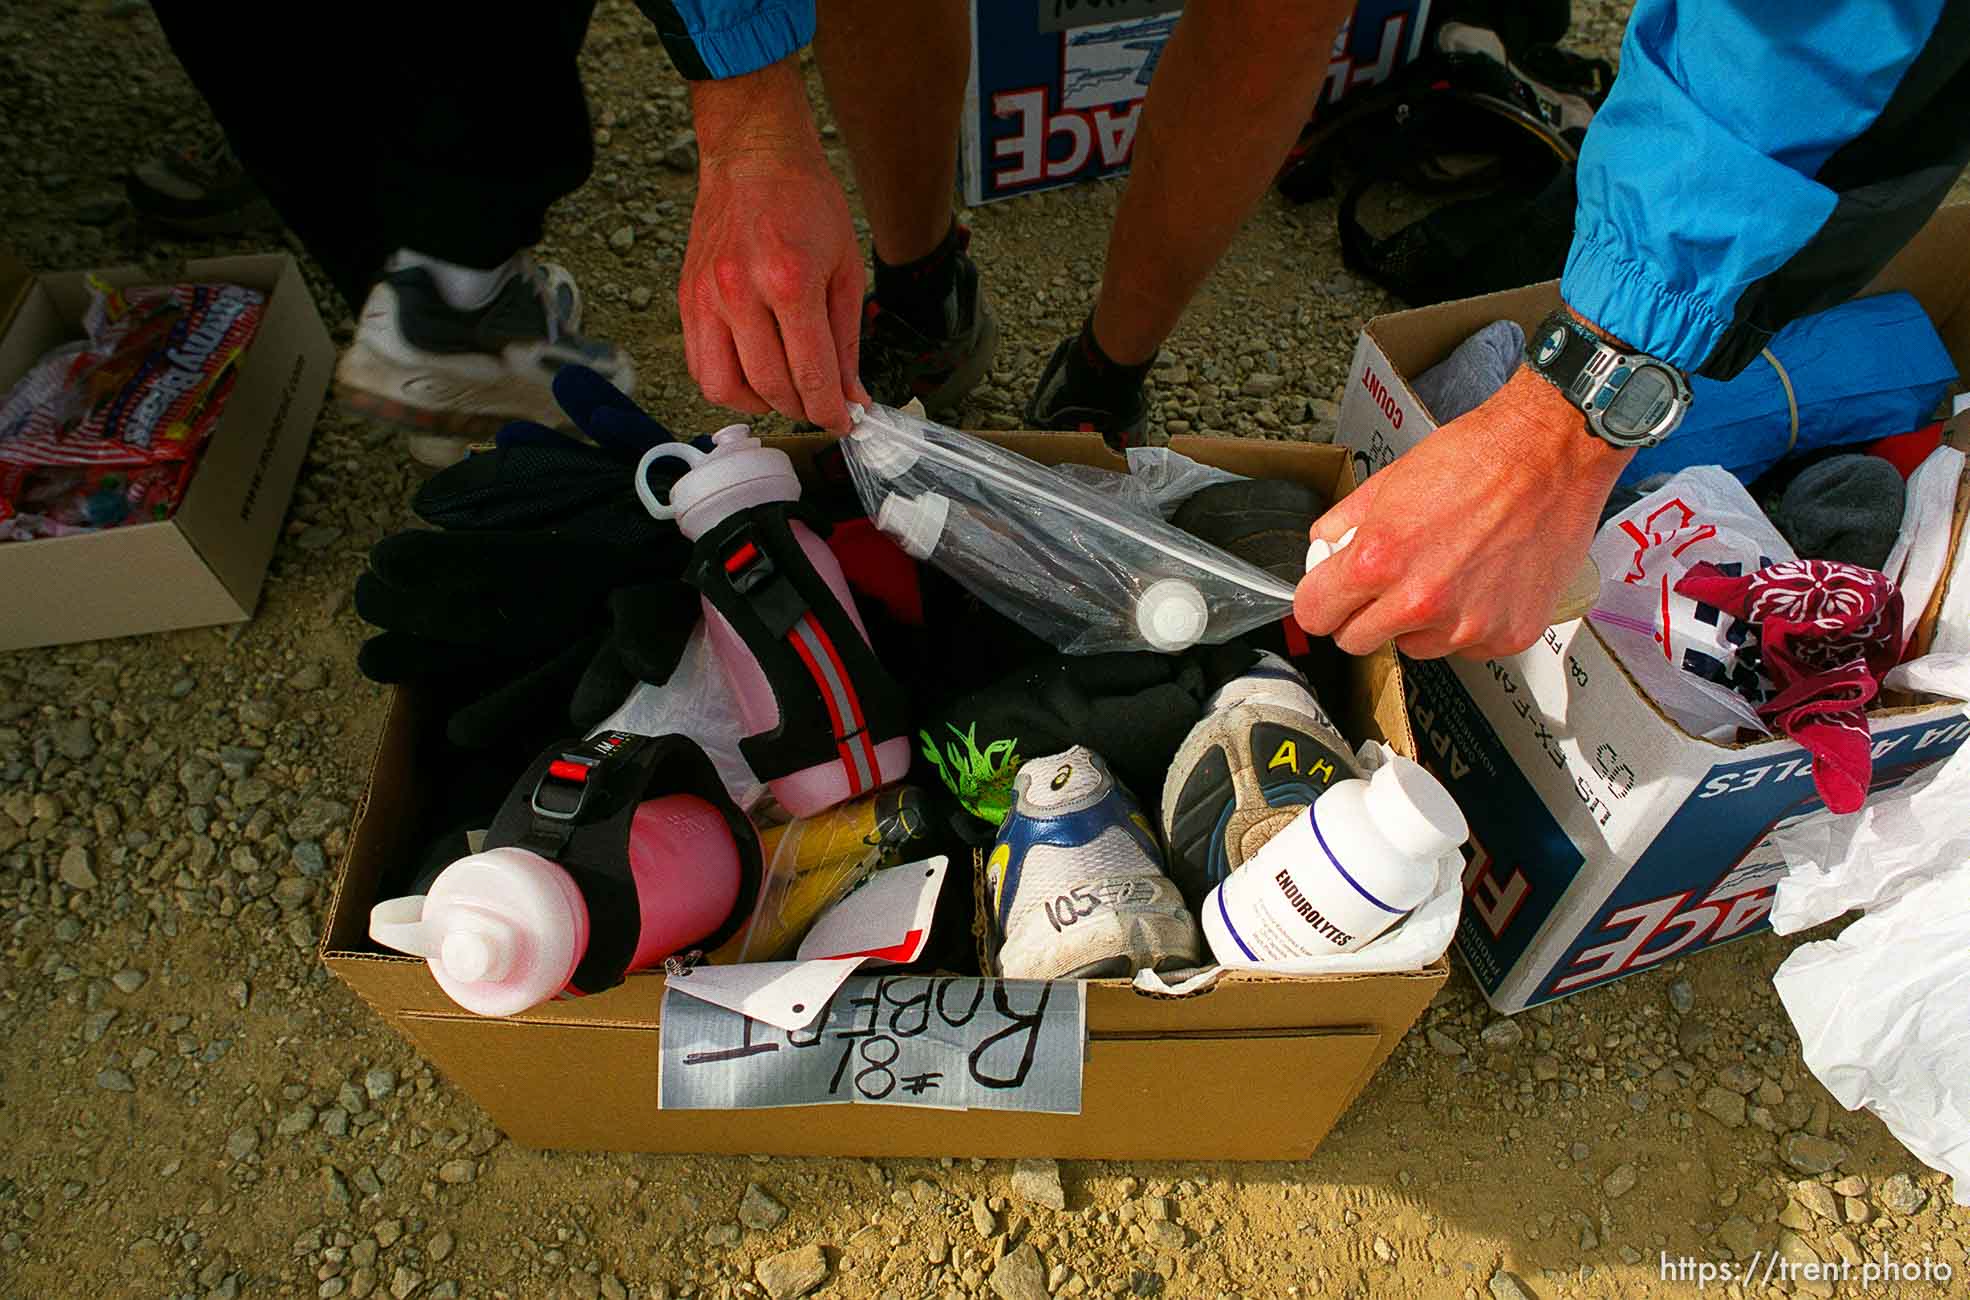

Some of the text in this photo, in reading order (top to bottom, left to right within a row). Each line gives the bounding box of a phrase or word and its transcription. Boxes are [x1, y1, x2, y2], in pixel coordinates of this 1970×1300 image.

[993, 88, 1144, 189] ACE
[1362, 366, 1403, 430] COUNT
[1699, 734, 1912, 799] APLES
[1045, 884, 1102, 933] 105
[1275, 868, 1356, 949] ENDUROLYTES
[1552, 890, 1773, 993] ACE
